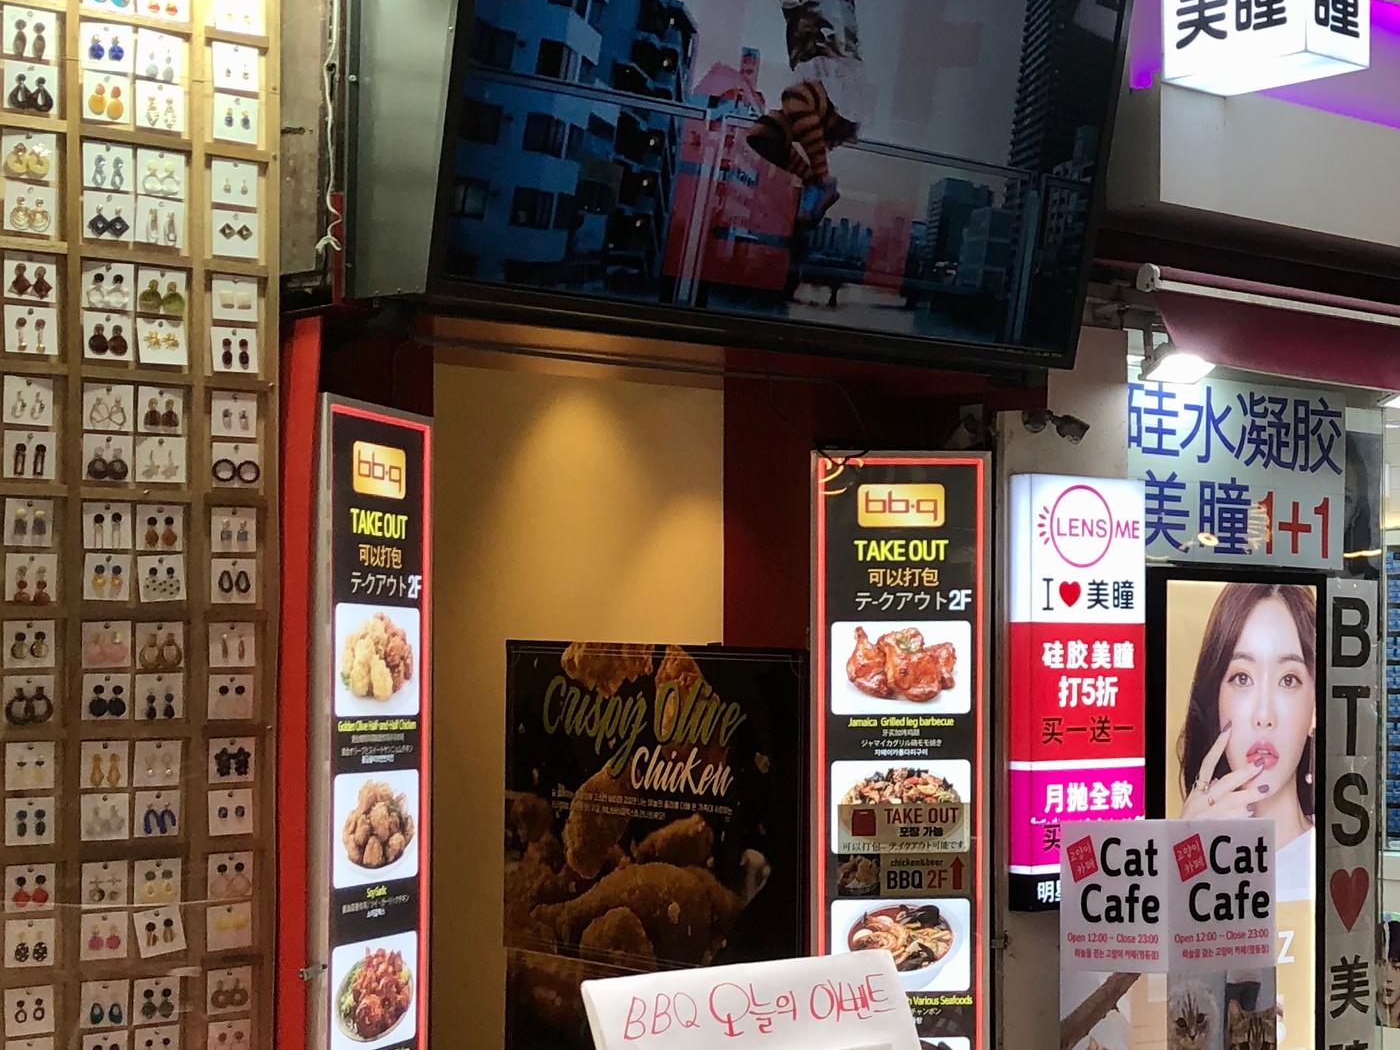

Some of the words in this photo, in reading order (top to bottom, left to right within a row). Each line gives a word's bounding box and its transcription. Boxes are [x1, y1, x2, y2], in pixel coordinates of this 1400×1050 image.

[350, 506, 384, 538] TAKE
[383, 512, 409, 540] OUT
[1056, 516, 1108, 540] LENS
[1114, 519, 1141, 540] ME
[358, 543, 402, 569] 可以打包
[853, 538, 907, 563] TAKE
[908, 538, 949, 563] OUT
[407, 573, 422, 600] 2F
[867, 567, 941, 588] 可以打包
[948, 588, 973, 612] 2F
[1042, 577, 1055, 612] I
[1086, 578, 1135, 611] 美瞳
[1041, 639, 1136, 672] 硅胶美瞳
[1058, 675, 1119, 709] 打5折
[847, 717, 878, 728] Jamaica
[880, 716, 906, 727] Grilled
[906, 716, 919, 729] leg
[919, 716, 955, 728] barbecue
[1041, 715, 1135, 745] 买一送一
[629, 745, 734, 798] Chicken
[1043, 782, 1135, 814] 月抛全款
[884, 807, 923, 825] TAKE
[927, 807, 959, 824] OUT
[898, 826, 920, 838] 포장
[1100, 836, 1159, 878] Cat
[1209, 834, 1268, 875] Cat
[886, 869, 923, 890] BBQ
[926, 869, 948, 890] 2F
[1080, 882, 1161, 925] Cafe
[1188, 879, 1271, 923] Cafe
[1067, 931, 1086, 944] Open
[1087, 932, 1108, 943] 12:00
[1116, 933, 1137, 944] Close
[1137, 933, 1159, 944] 23:00
[1174, 933, 1194, 944] Open
[1195, 931, 1218, 943] 12:00
[1226, 930, 1246, 941] Close
[1247, 928, 1269, 939] 23:00
[623, 991, 700, 1041] BBQ
[708, 981, 797, 1038] 오늘의
[912, 995, 940, 1006] Various
[939, 994, 974, 1006] Seafoods
